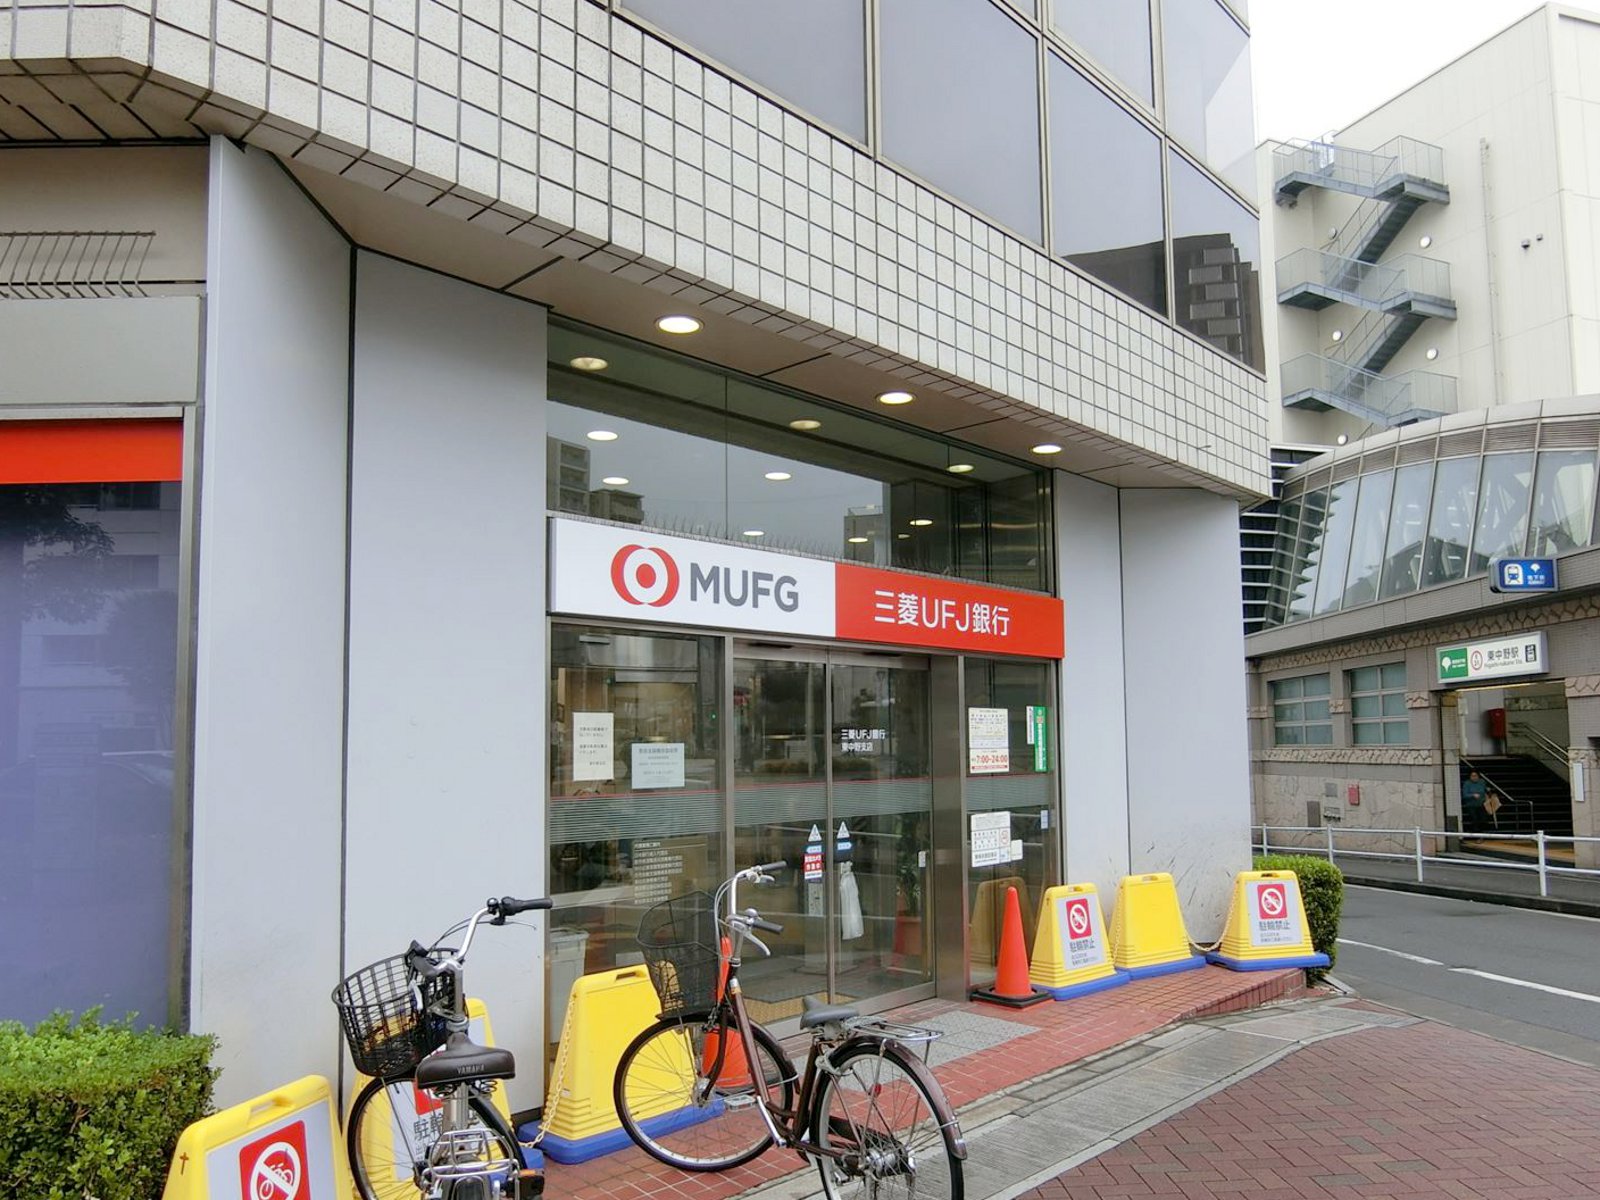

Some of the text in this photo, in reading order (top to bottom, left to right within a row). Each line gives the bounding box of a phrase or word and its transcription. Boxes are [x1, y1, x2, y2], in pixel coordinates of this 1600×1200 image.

[690, 562, 799, 613] MUFG
[874, 590, 1010, 636] 三菱UFJ銀行
[1487, 646, 1519, 661] 東中野駅
[840, 729, 886, 740] 三菱UFJ銀行
[457, 1064, 485, 1074] YAMAHA
